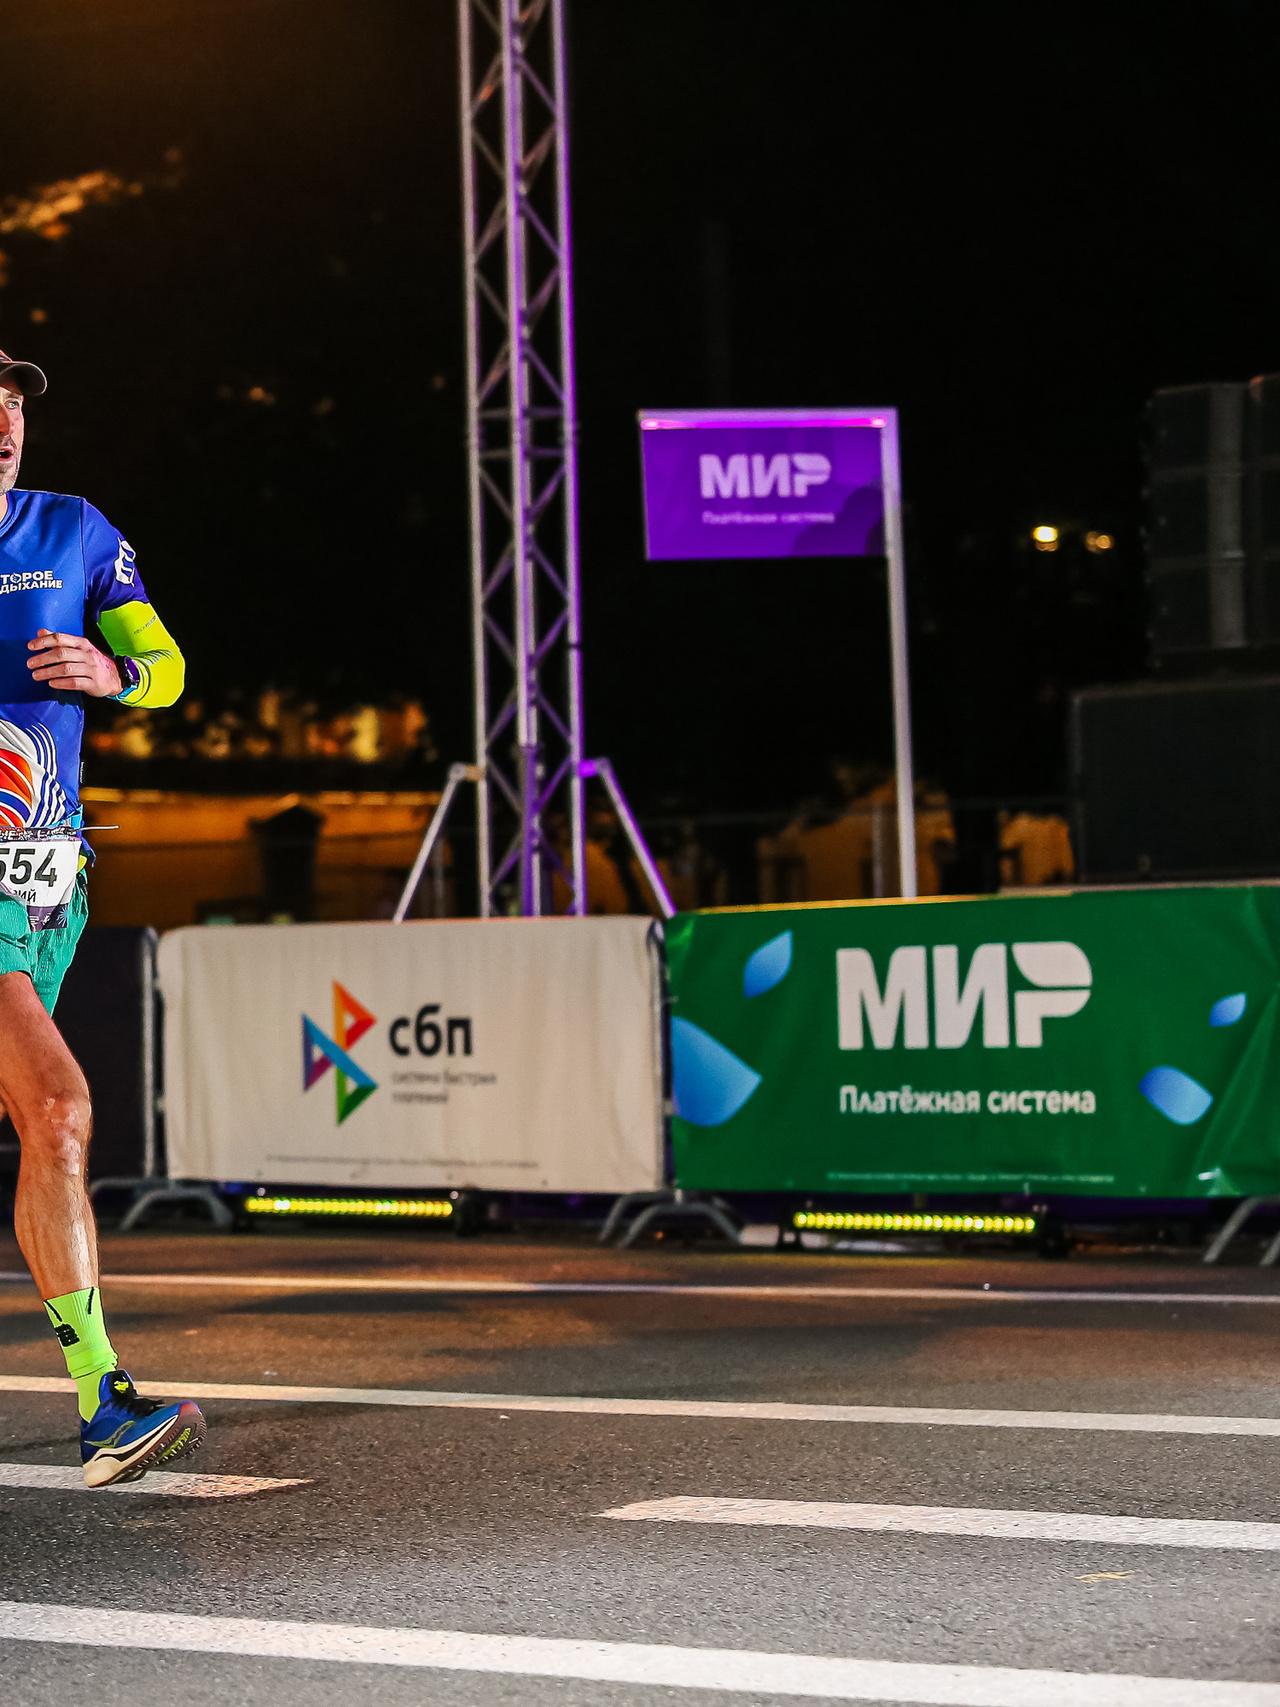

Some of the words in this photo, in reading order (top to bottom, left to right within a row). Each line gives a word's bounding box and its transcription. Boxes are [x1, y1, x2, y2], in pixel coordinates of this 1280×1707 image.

[699, 453, 832, 498] МИР
[0, 579, 63, 595] ДЫХАНИЕ
[836, 940, 1093, 1050] МИР
[389, 1004, 473, 1057] сбп
[839, 1085, 981, 1114] Платёжная
[987, 1091, 1096, 1114] система
